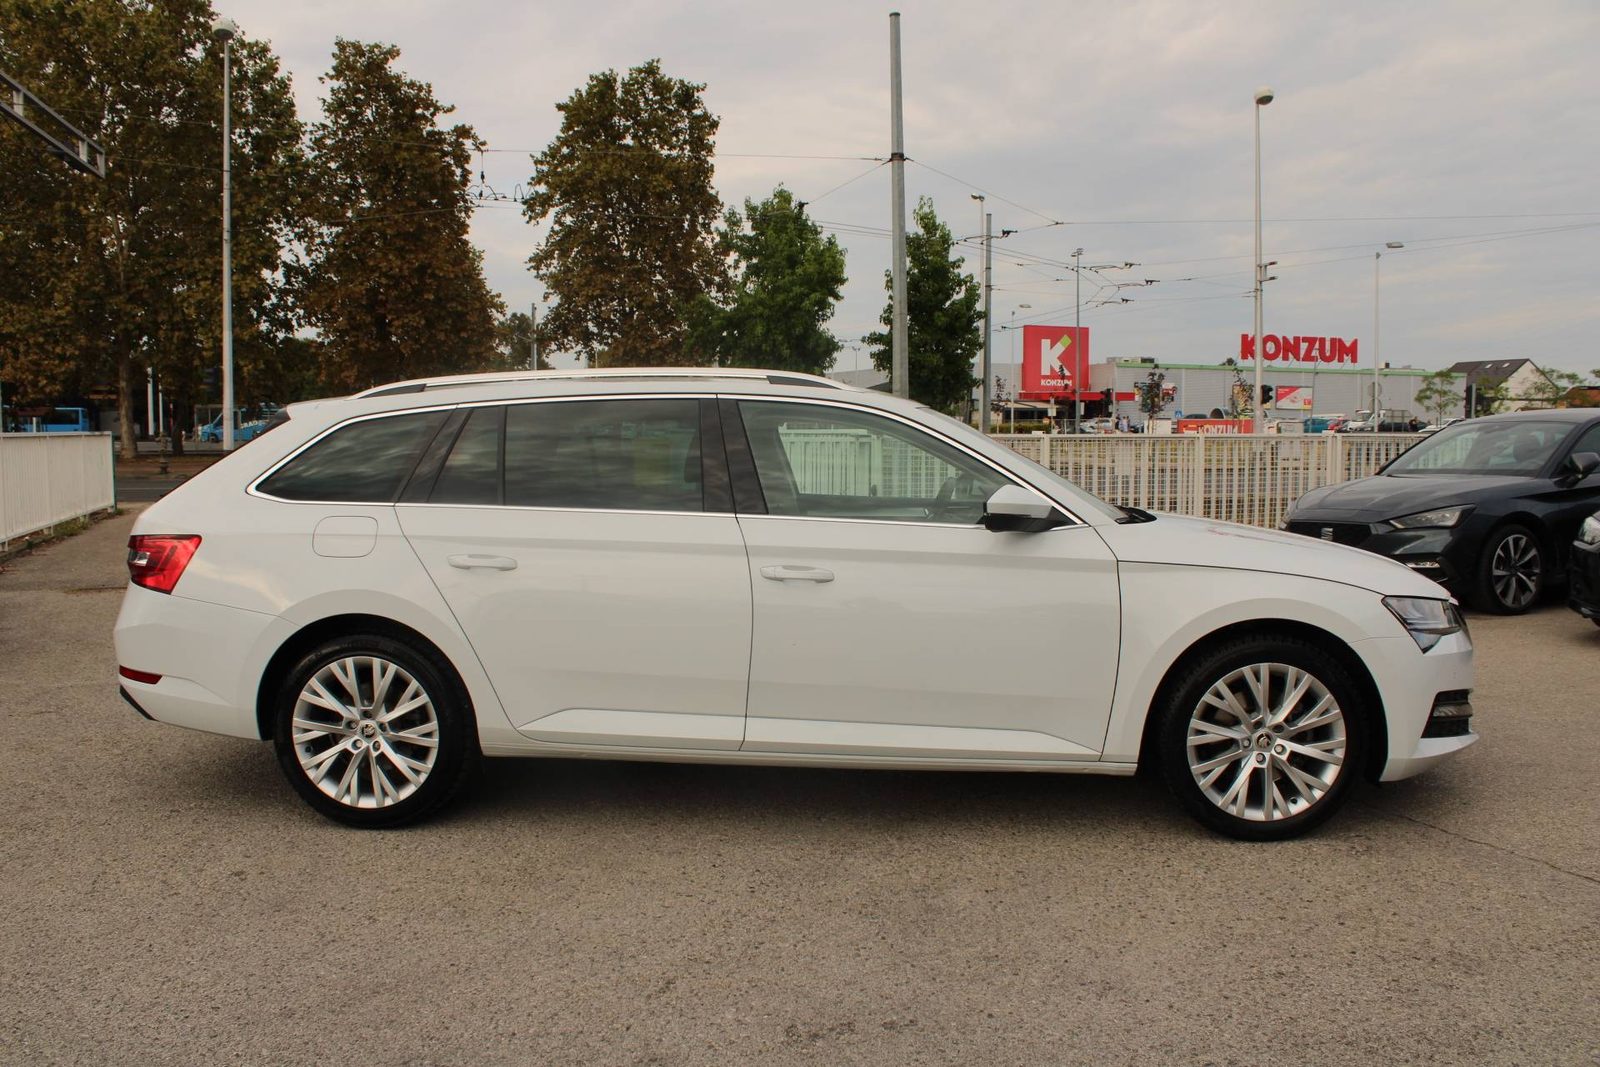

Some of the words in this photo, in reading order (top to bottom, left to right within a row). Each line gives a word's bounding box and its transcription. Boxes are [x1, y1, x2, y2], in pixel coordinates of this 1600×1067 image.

[1041, 334, 1072, 376] K
[1240, 334, 1358, 363] KONZUM
[1040, 379, 1073, 387] KONZUM
